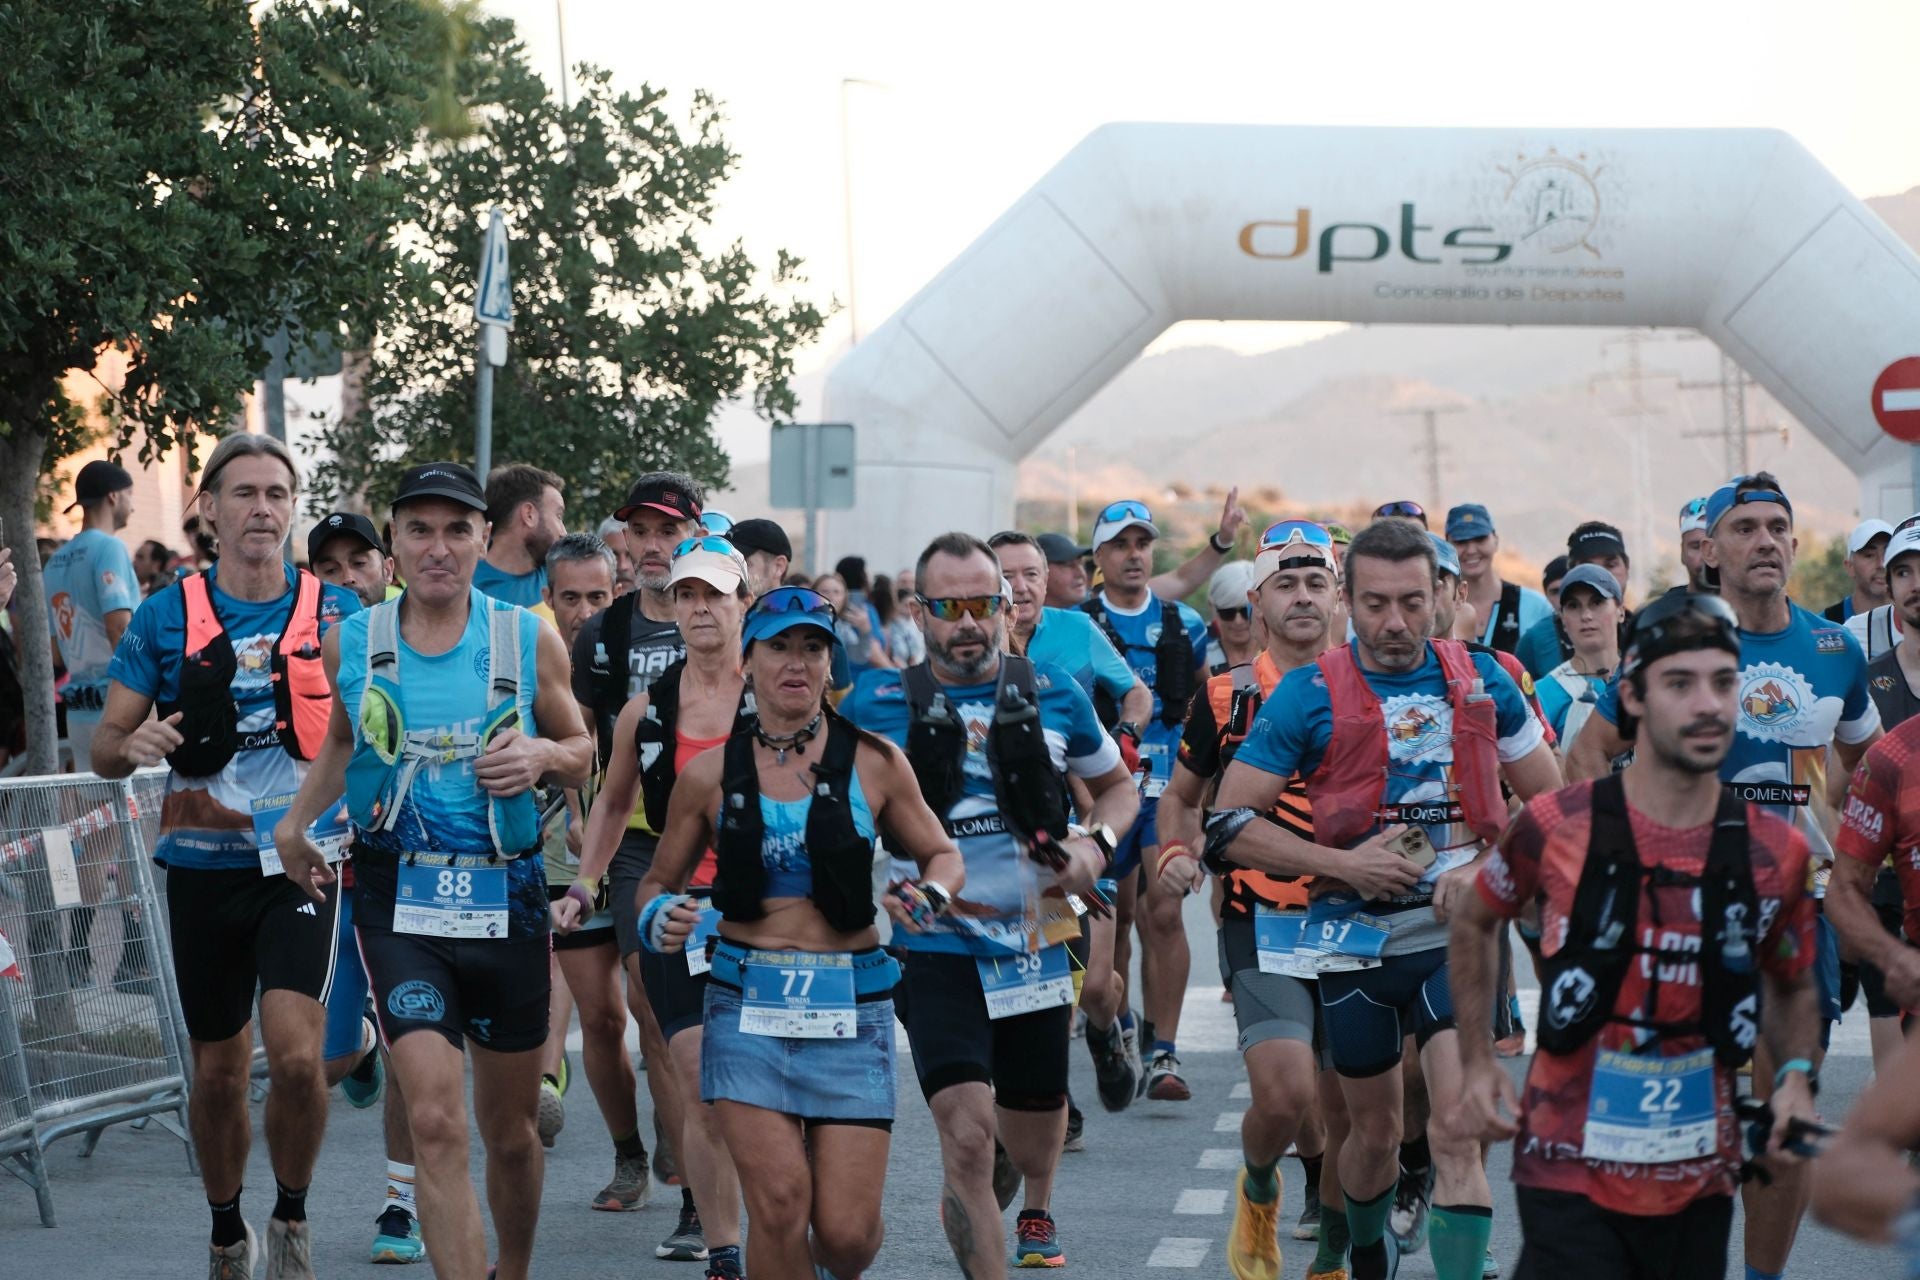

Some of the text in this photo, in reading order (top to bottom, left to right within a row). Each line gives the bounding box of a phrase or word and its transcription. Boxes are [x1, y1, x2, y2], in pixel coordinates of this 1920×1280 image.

[1238, 202, 1514, 274] dpts
[1496, 284, 1525, 301] de
[1531, 284, 1626, 303] Deportes
[419, 469, 457, 480] unimar
[1733, 786, 1793, 802] LOMEN
[436, 870, 472, 897] 88
[1321, 920, 1352, 944] 61
[779, 969, 815, 997] 77
[1639, 1078, 1683, 1113] 22
